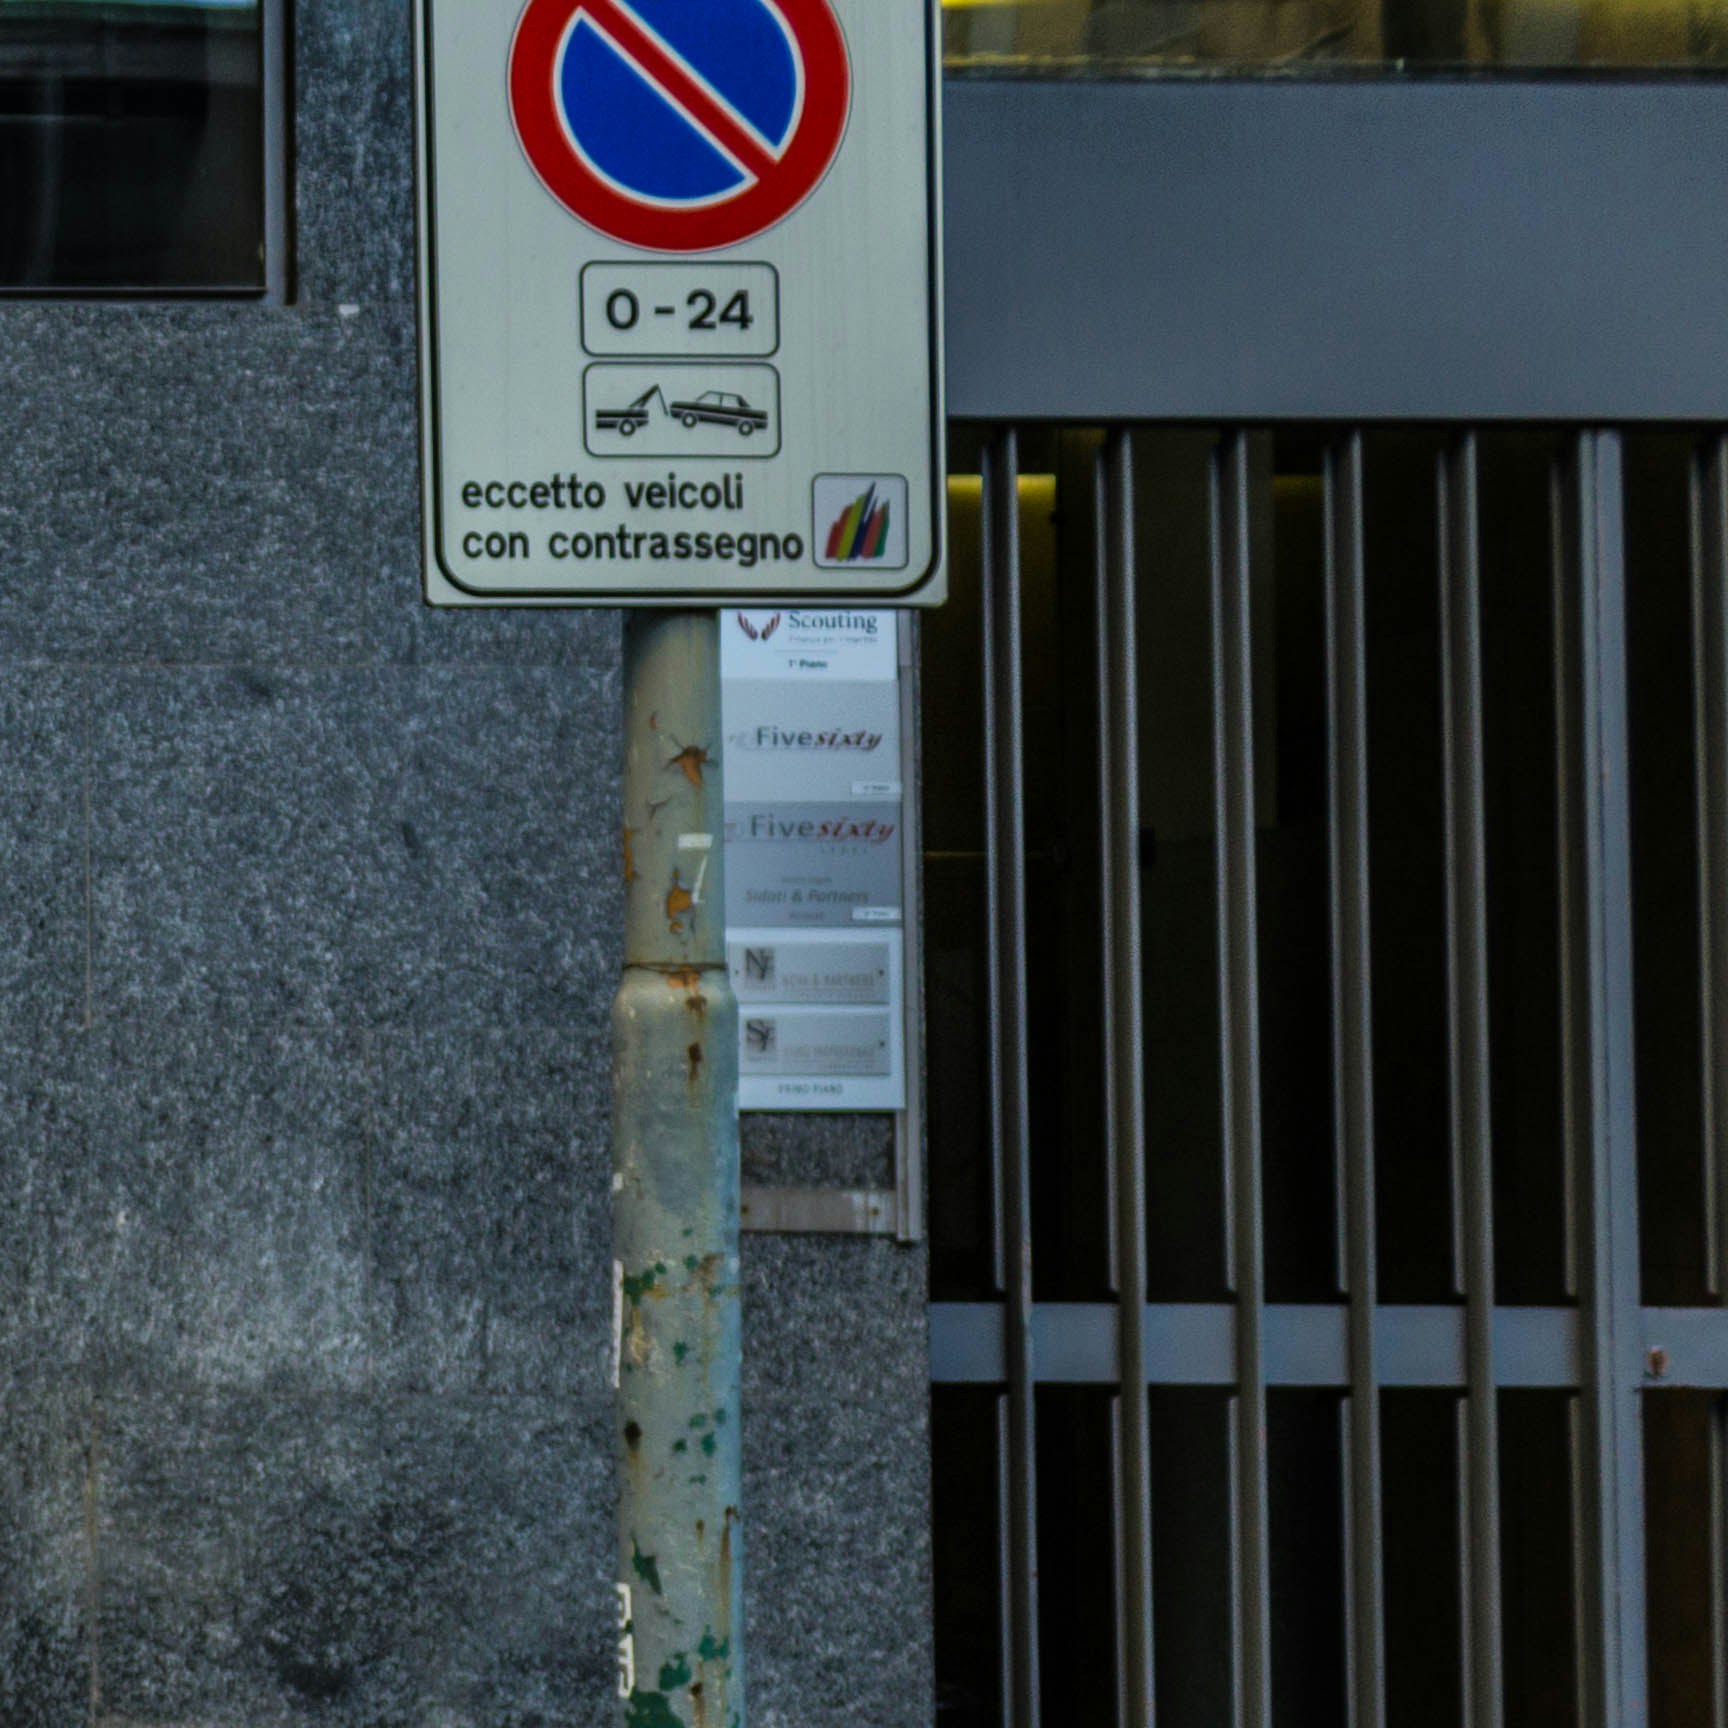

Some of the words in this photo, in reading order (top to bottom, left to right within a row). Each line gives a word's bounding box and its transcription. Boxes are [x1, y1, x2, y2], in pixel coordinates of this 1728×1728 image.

[605, 288, 639, 331] 0
[686, 288, 754, 331] 24
[461, 474, 606, 510] eccetto
[624, 472, 744, 510] veicoli
[462, 530, 530, 561] con
[548, 524, 805, 567] contrassegno
[788, 609, 879, 634] Scouting
[755, 725, 883, 750] Fivesixty
[750, 813, 895, 844] Fivesixty
